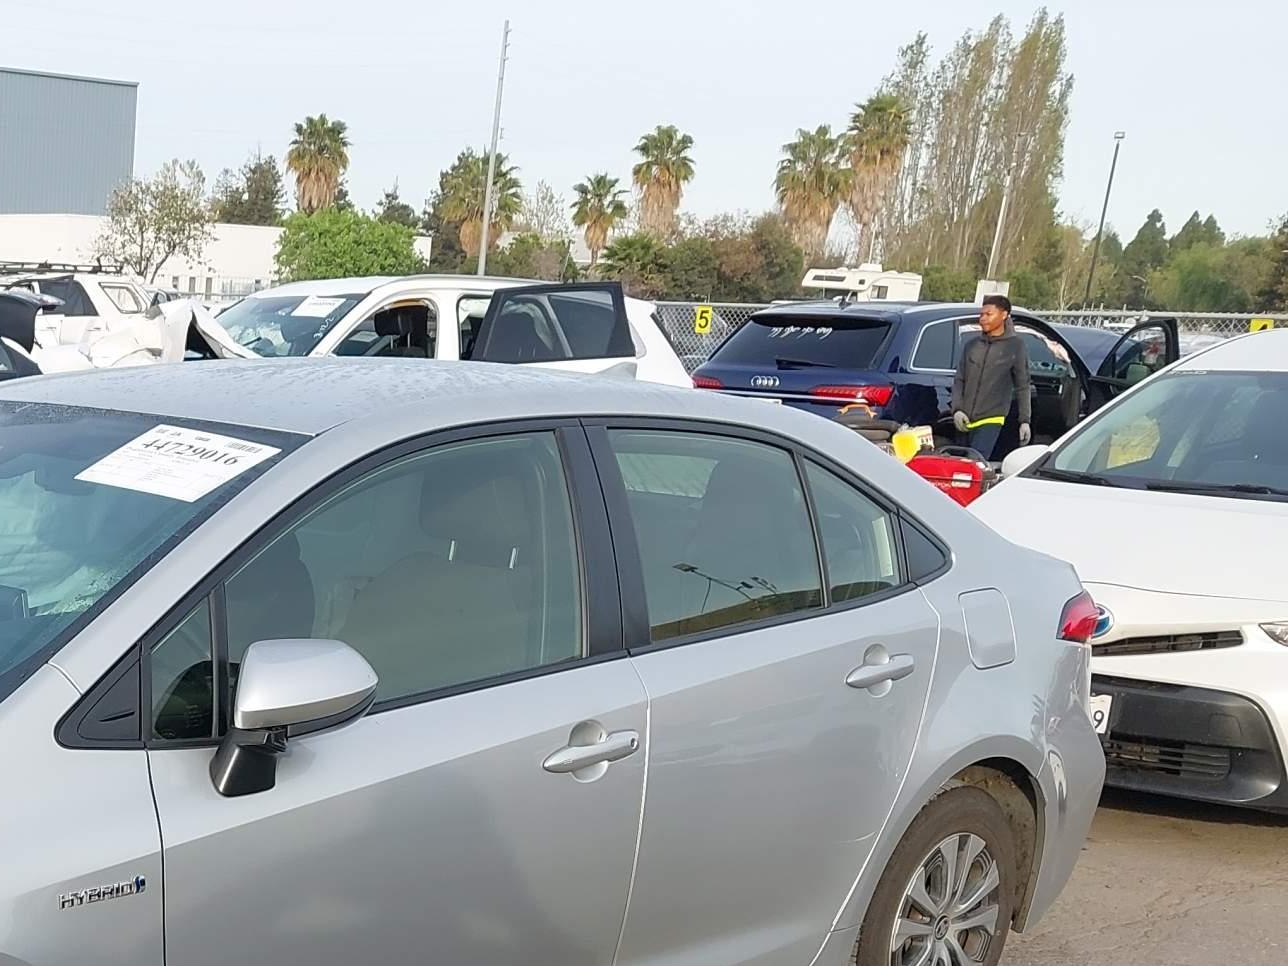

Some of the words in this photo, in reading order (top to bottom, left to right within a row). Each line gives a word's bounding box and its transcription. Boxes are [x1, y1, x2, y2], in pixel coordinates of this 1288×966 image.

[698, 309, 710, 329] 5
[142, 438, 245, 466] 44729016
[58, 880, 134, 910] HYBRID
